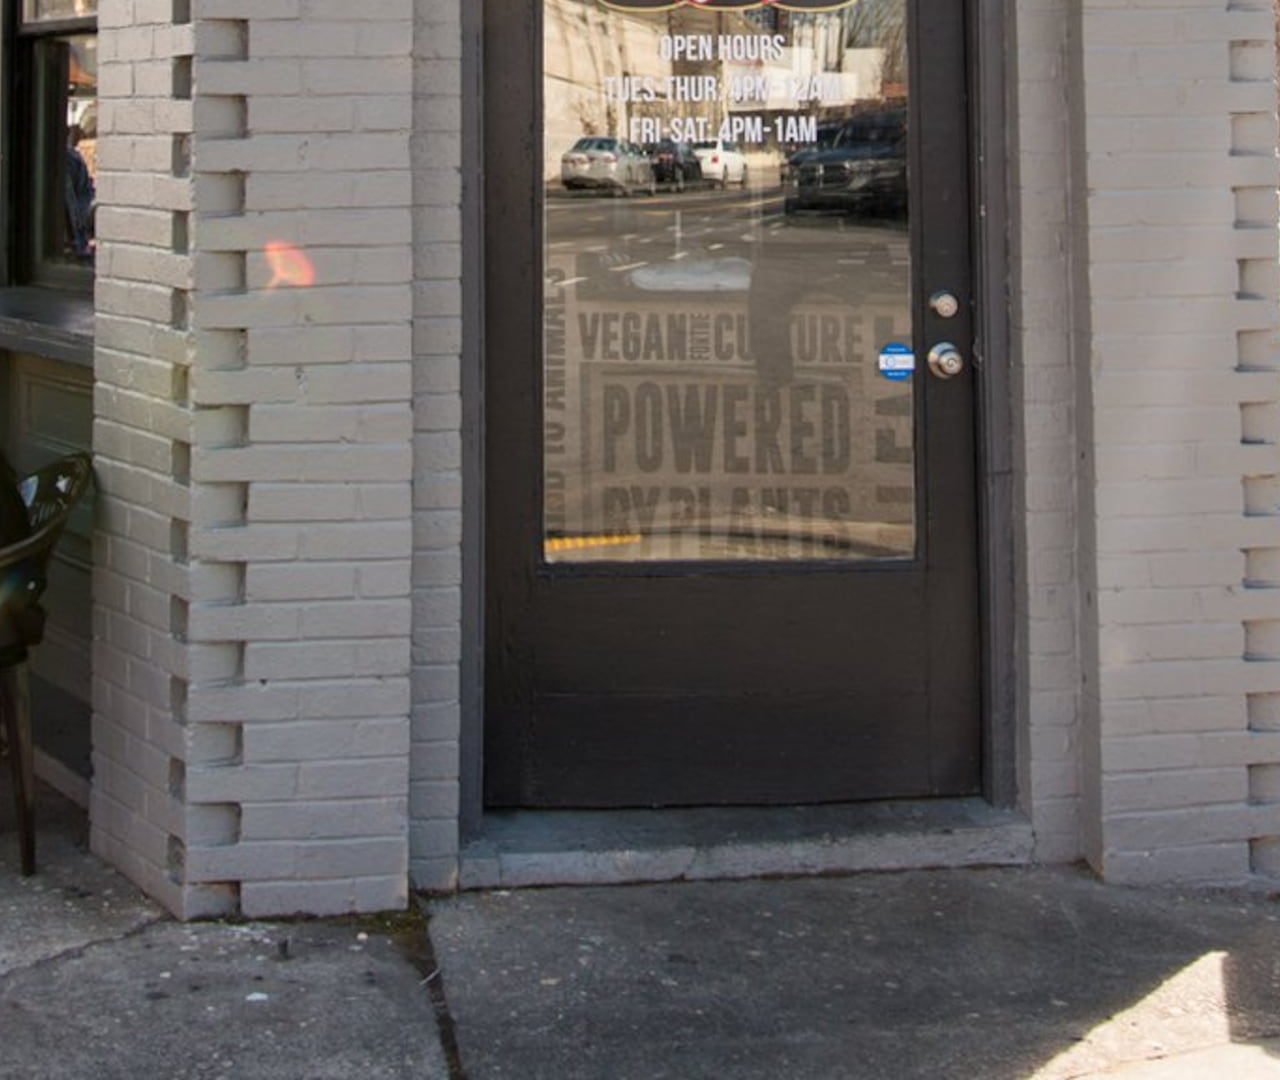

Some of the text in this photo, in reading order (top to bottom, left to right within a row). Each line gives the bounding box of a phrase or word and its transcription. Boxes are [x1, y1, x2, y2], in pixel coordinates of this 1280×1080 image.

[660, 35, 785, 62] OPEN HOURS
[578, 313, 687, 361] VEGAN
[603, 383, 851, 475] POWERED
